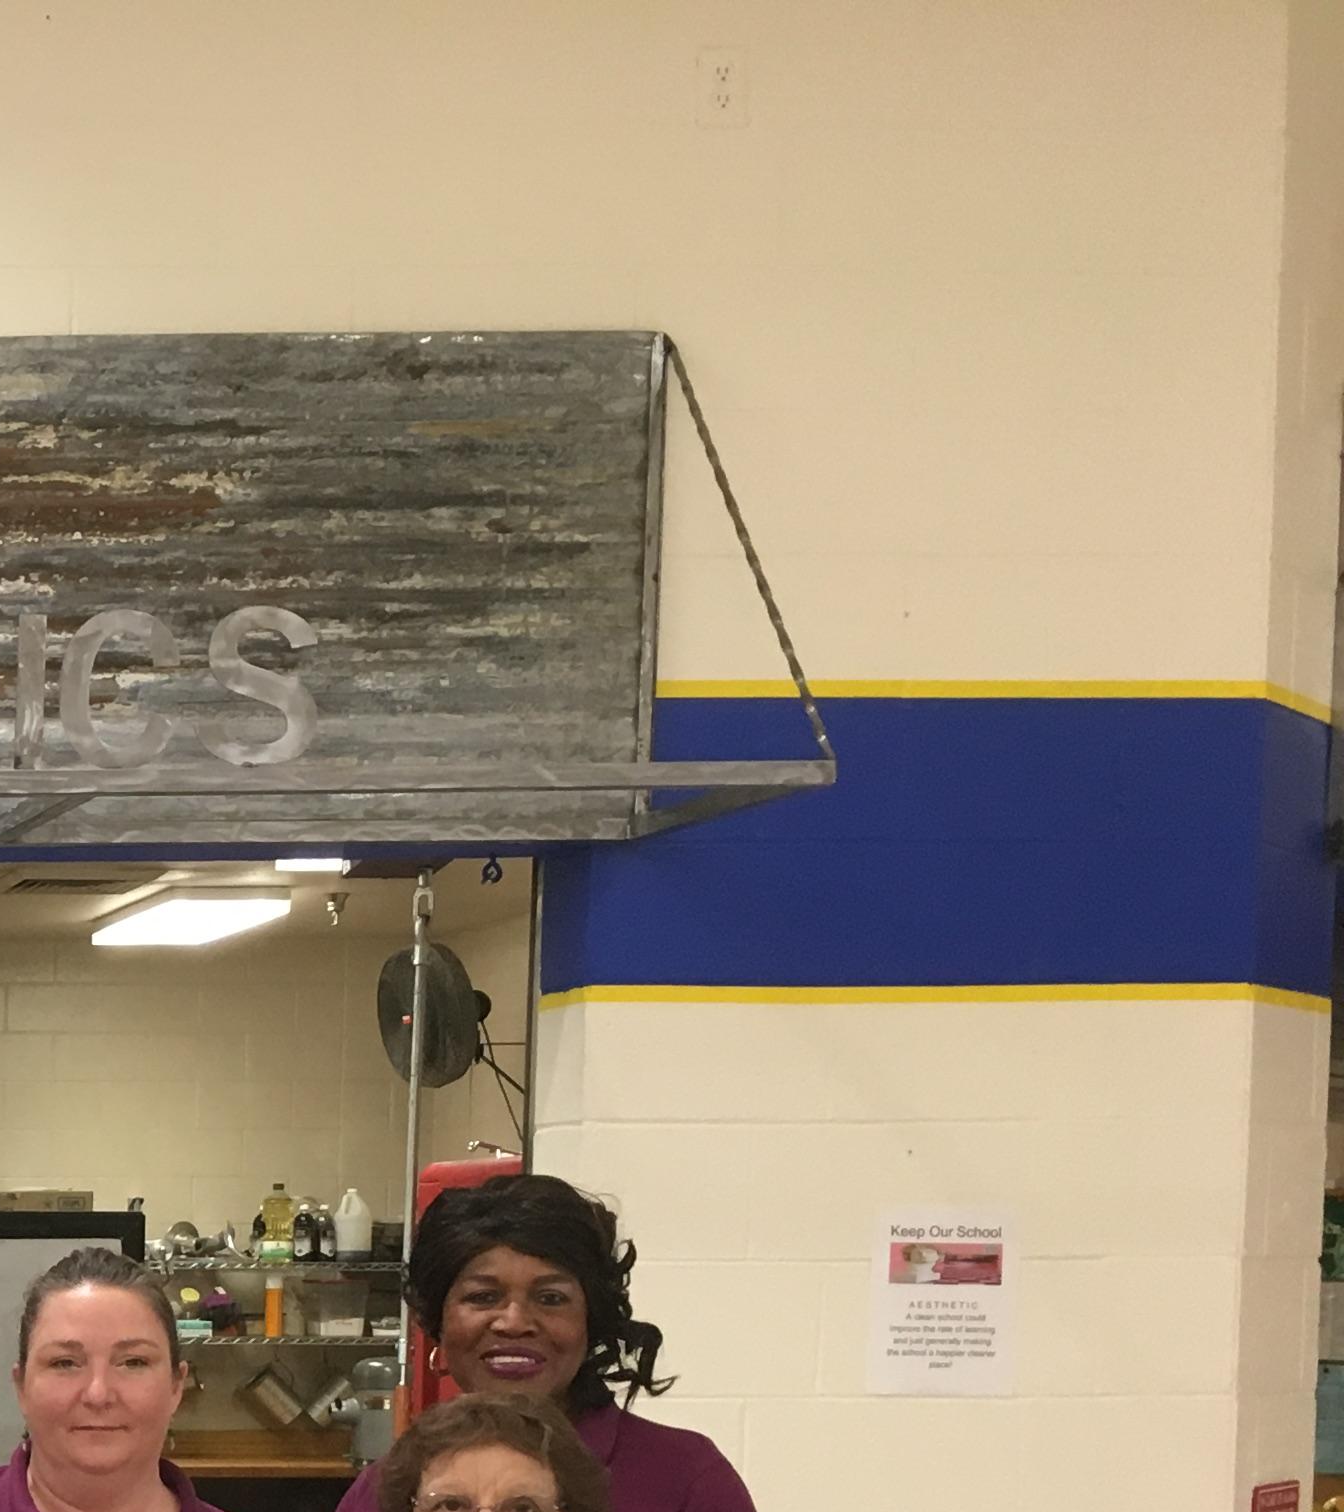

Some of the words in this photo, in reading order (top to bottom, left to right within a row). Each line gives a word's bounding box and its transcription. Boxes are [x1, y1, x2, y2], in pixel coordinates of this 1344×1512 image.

[890, 1225, 925, 1239] Keep
[929, 1225, 953, 1238] Our
[957, 1225, 1002, 1239] School
